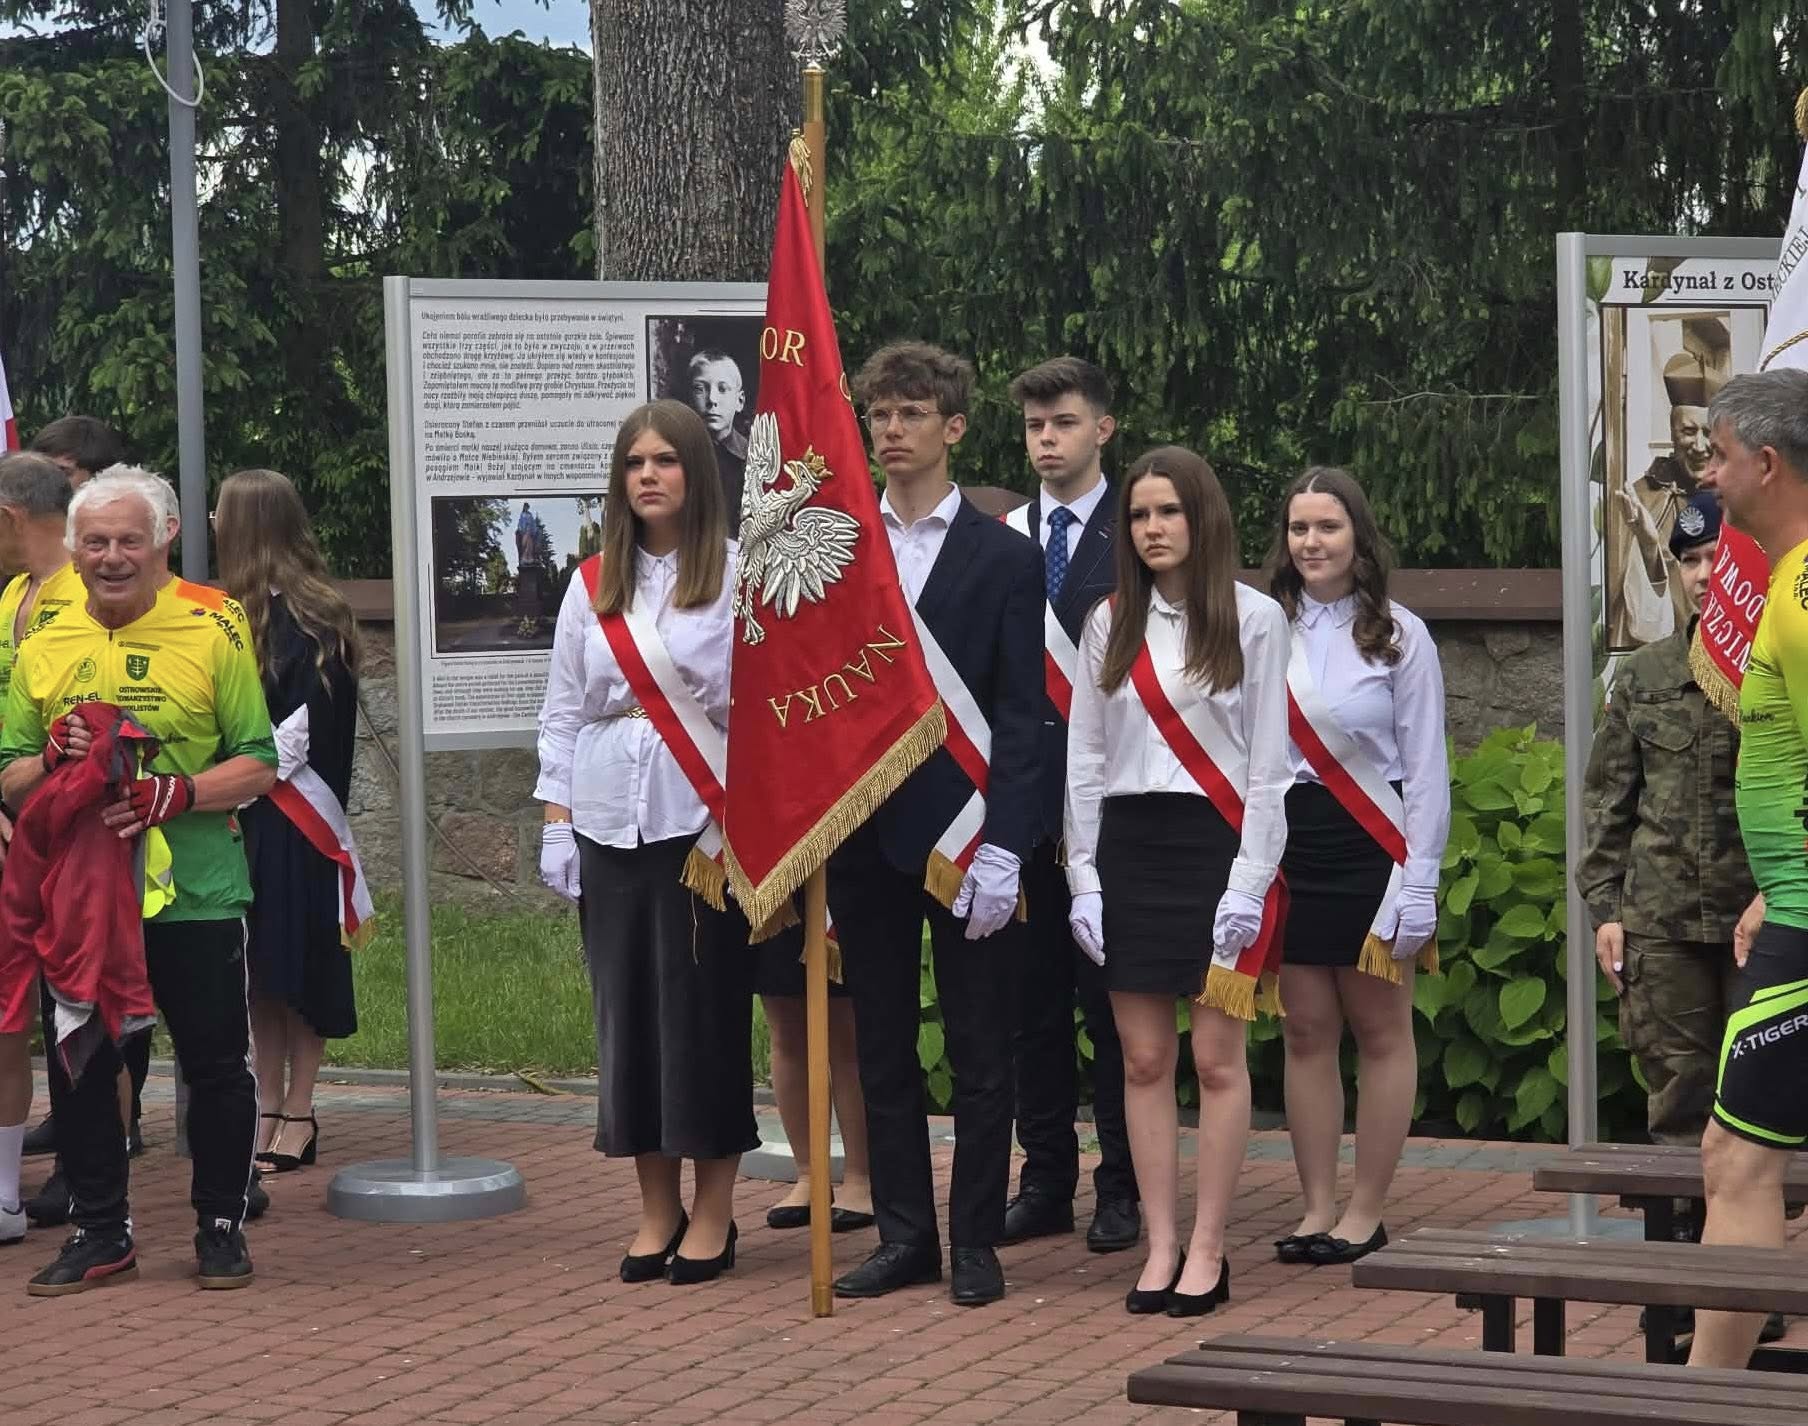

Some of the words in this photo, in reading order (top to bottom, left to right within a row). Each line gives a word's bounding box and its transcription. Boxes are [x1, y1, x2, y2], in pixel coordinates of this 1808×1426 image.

[1623, 270, 1717, 294] Kardynał
[1723, 276, 1735, 289] z
[760, 327, 806, 367] OR
[767, 624, 907, 728] NAUKA
[63, 691, 102, 706] REN-EL
[125, 703, 160, 712] KLISTÓW
